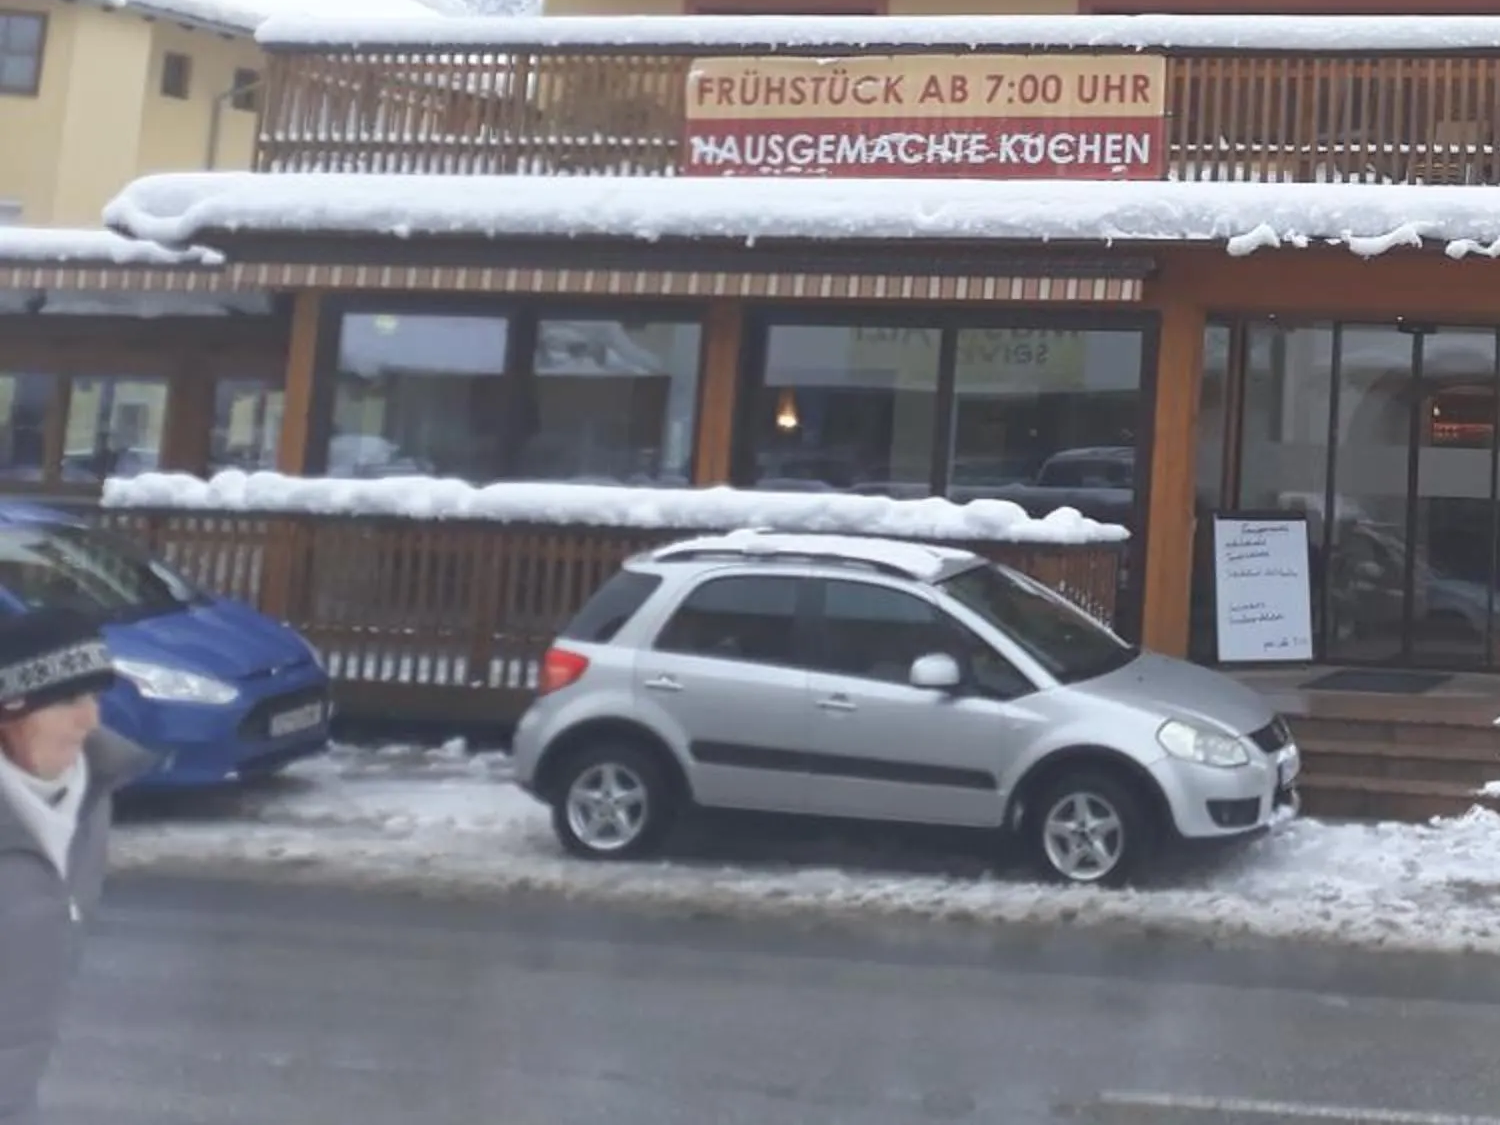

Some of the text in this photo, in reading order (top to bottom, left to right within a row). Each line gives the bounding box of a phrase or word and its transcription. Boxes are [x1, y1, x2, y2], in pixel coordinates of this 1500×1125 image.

[697, 68, 1151, 106] FRÜHSTÜCK AB 7:00 UHR
[690, 132, 1150, 165] HAUSGEMACHTE KUCHEN
